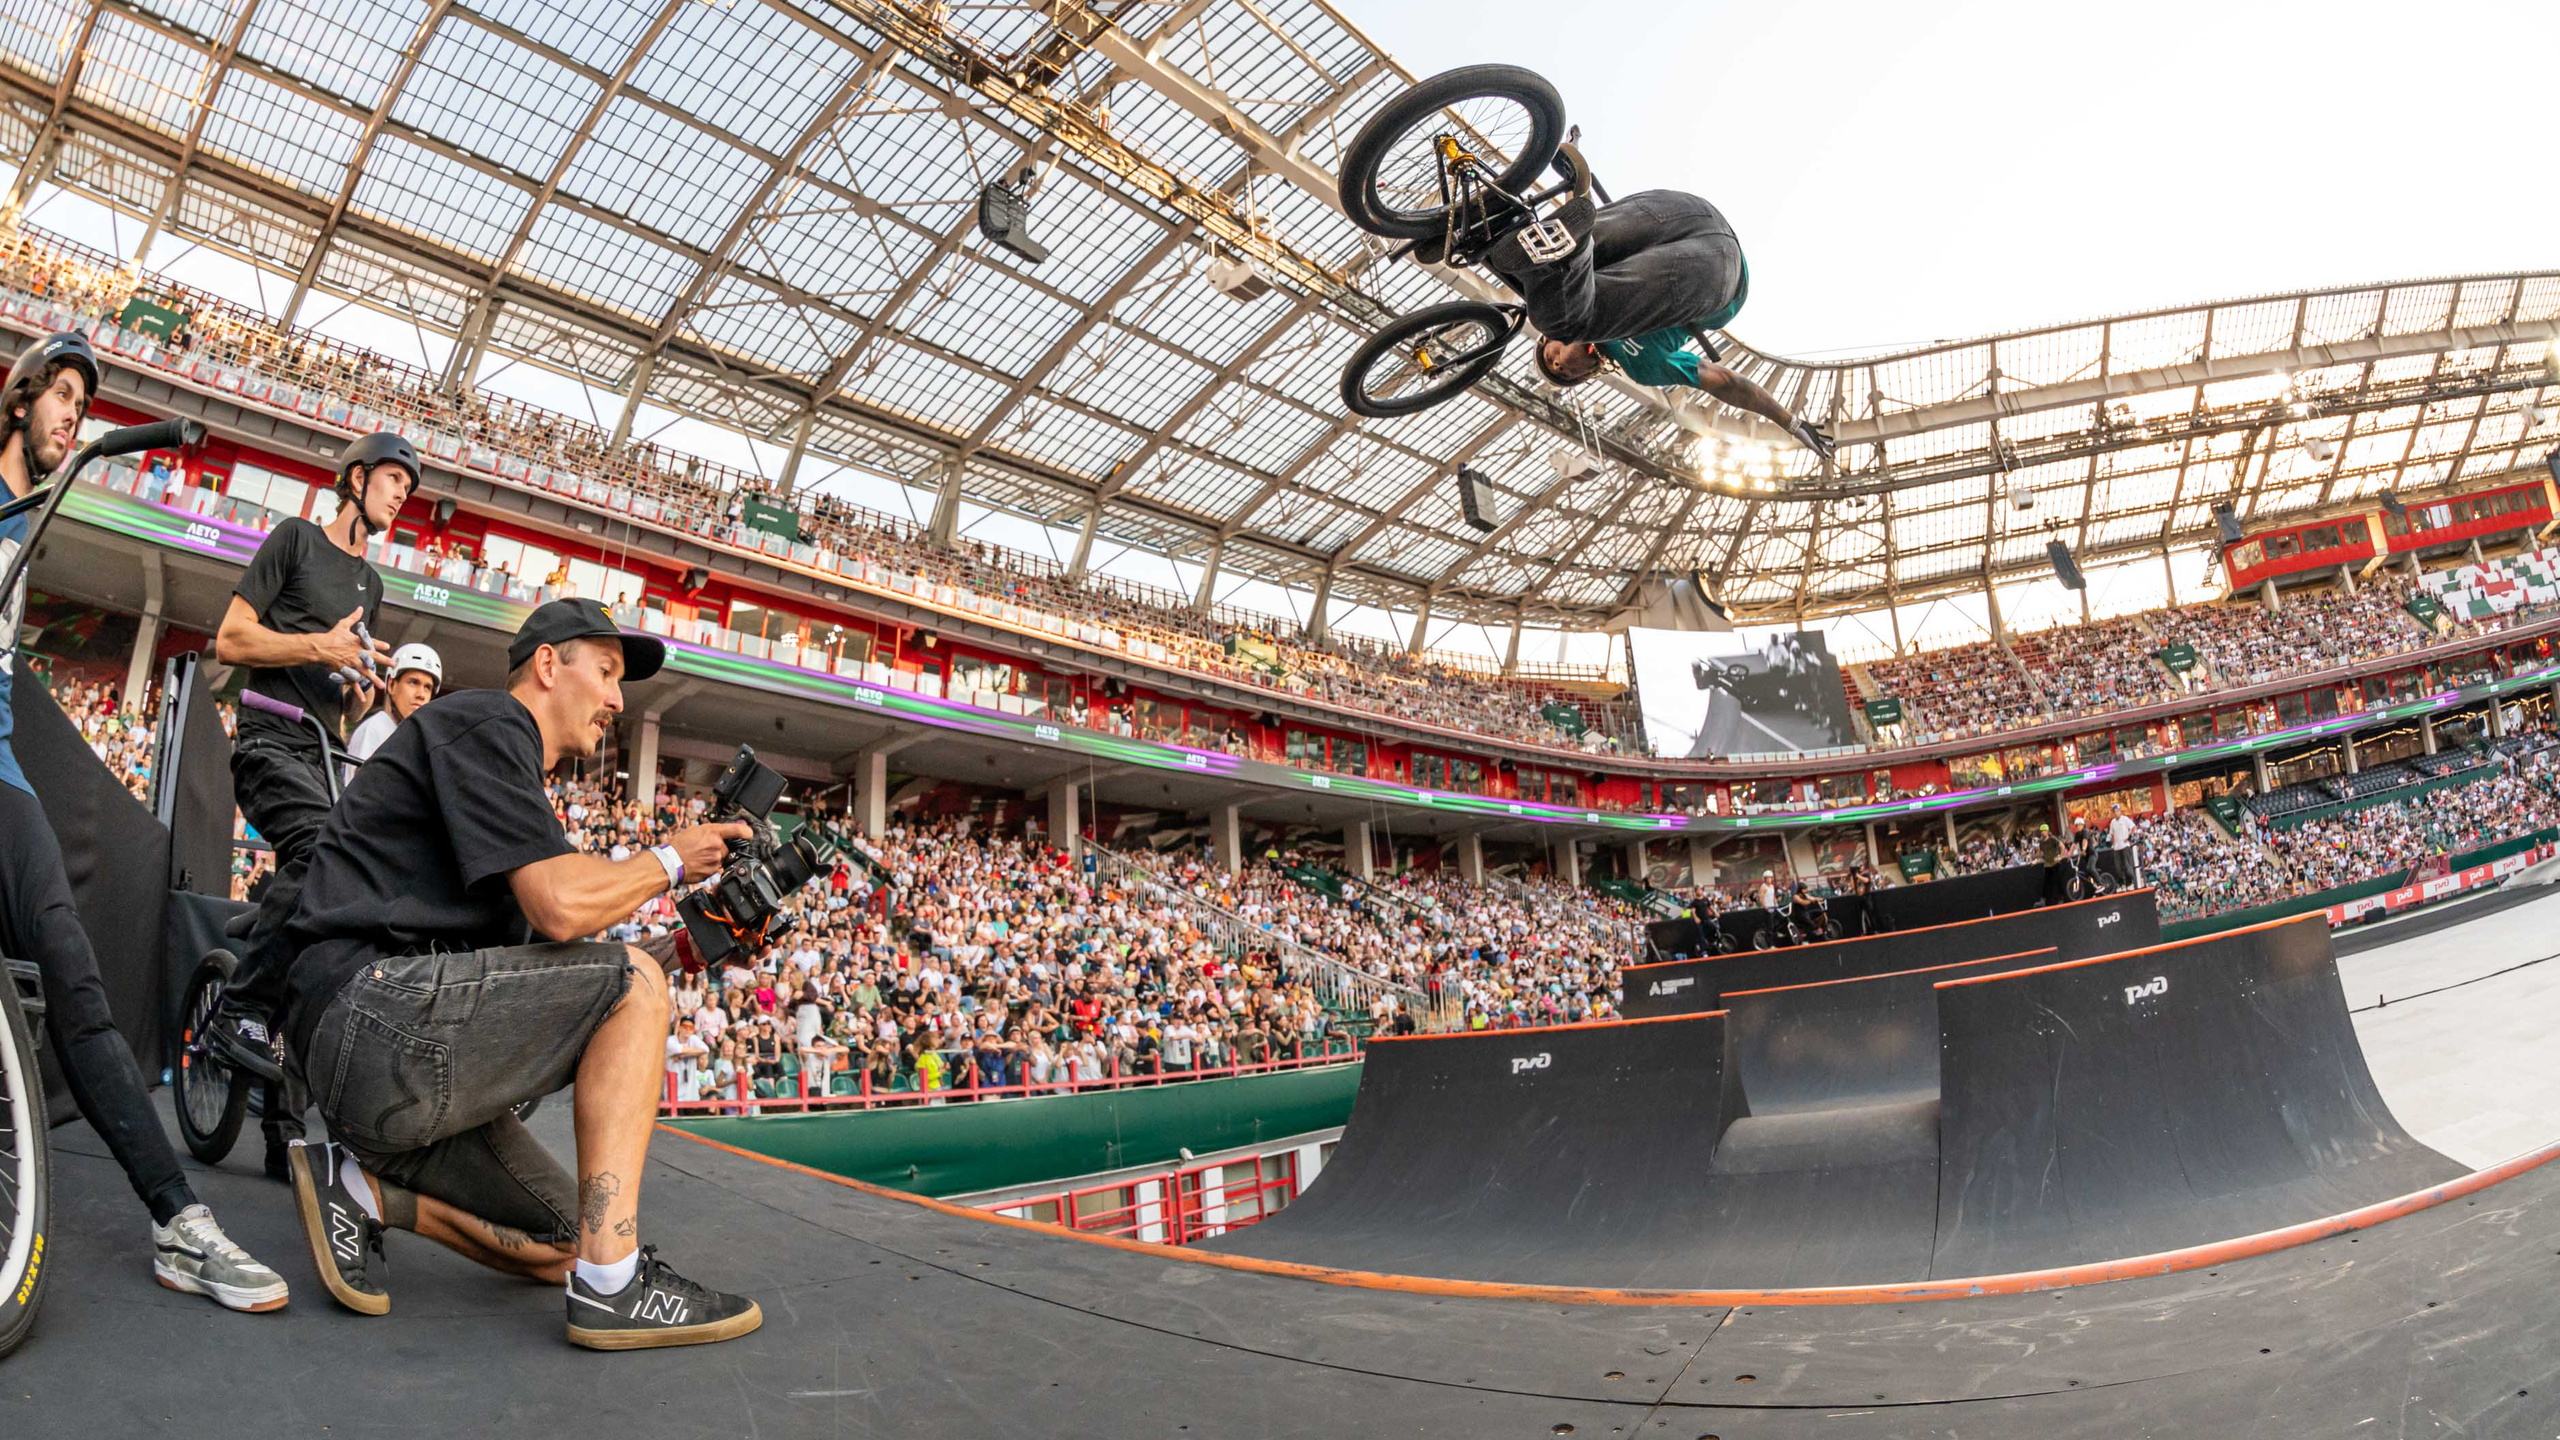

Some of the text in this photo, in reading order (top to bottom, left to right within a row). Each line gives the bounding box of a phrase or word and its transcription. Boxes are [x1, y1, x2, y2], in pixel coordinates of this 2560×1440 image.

[186, 522, 220, 540] ЛЕТО
[414, 583, 450, 600] ЛЕТО
[17, 1232, 44, 1306] MAXXIS
